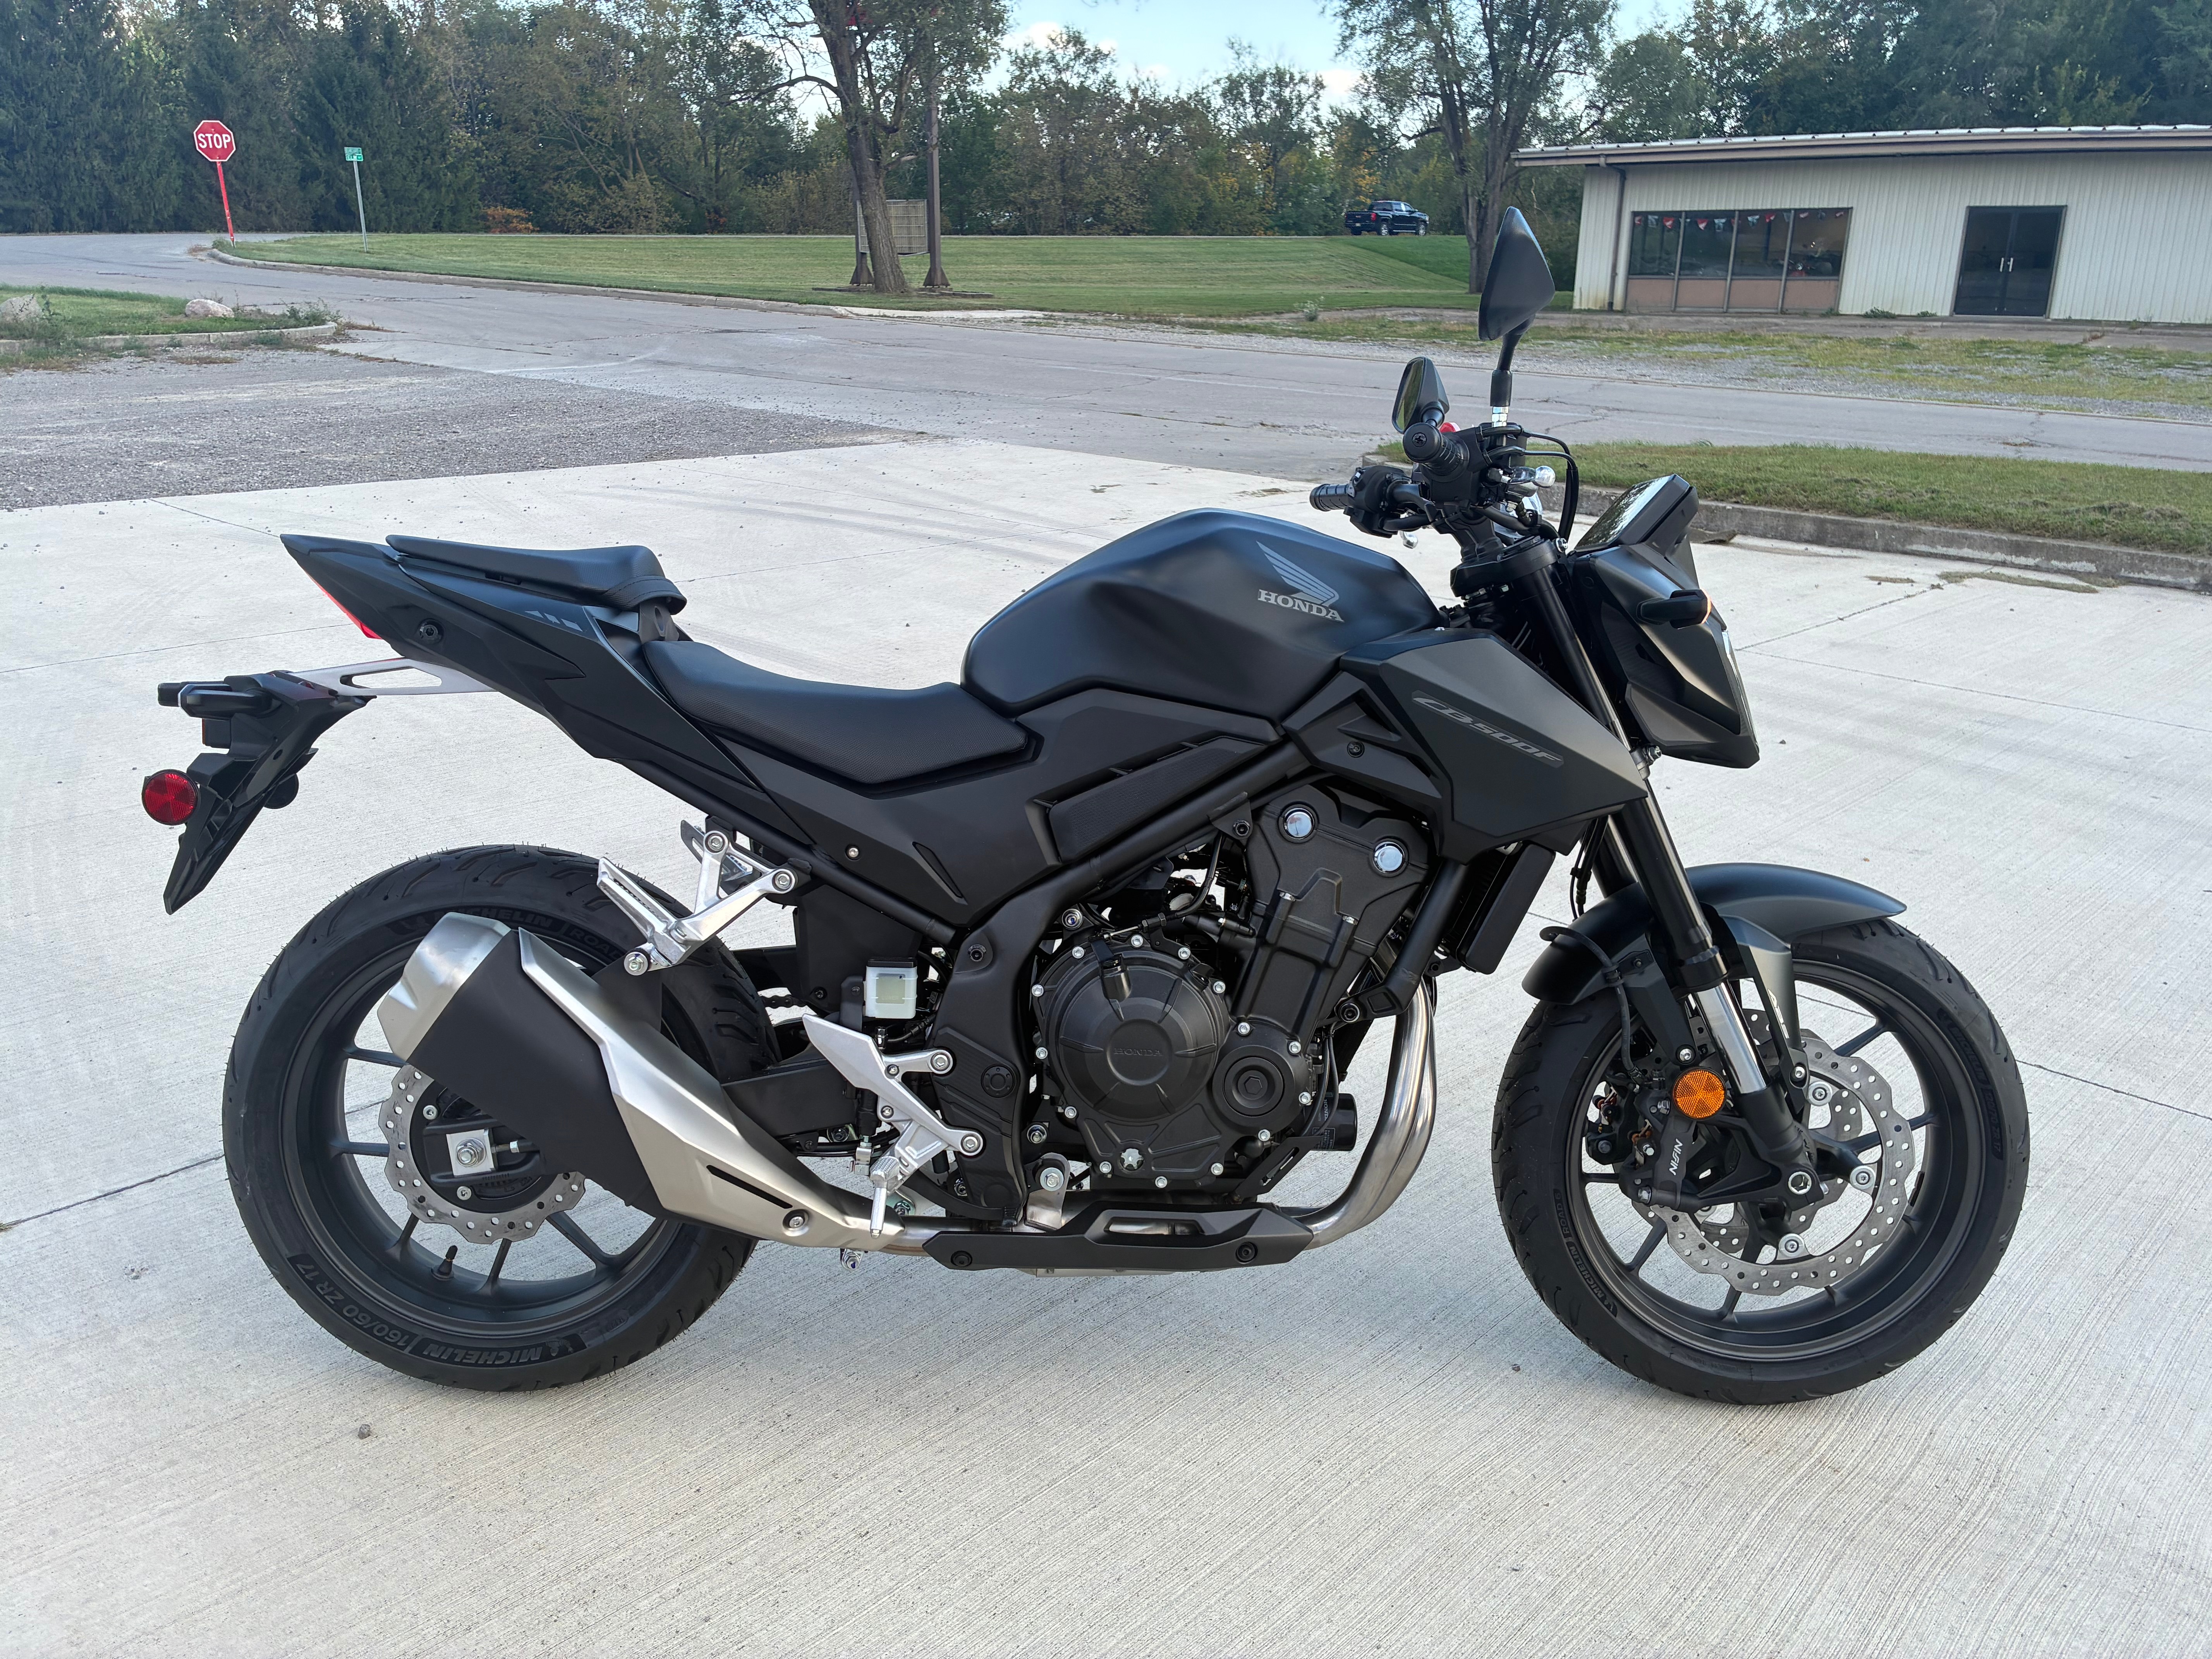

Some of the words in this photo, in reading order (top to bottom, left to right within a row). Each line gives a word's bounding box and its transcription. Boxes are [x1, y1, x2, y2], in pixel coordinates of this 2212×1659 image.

[198, 133, 231, 148] STOP
[1258, 589, 1345, 622] HONDA
[1413, 697, 1563, 761] CB500F
[1768, 989, 1790, 1039] ABS
[1114, 1048, 1163, 1057] HONDA
[1994, 1142, 2001, 1152] 17
[1556, 1202, 1570, 1234] ROAD
[296, 1264, 319, 1281] 17
[1570, 1246, 1606, 1298] MICHELIN
[316, 1281, 344, 1304] ZR
[343, 1304, 409, 1346] 160/60
[422, 1343, 543, 1364] MICHELIN
